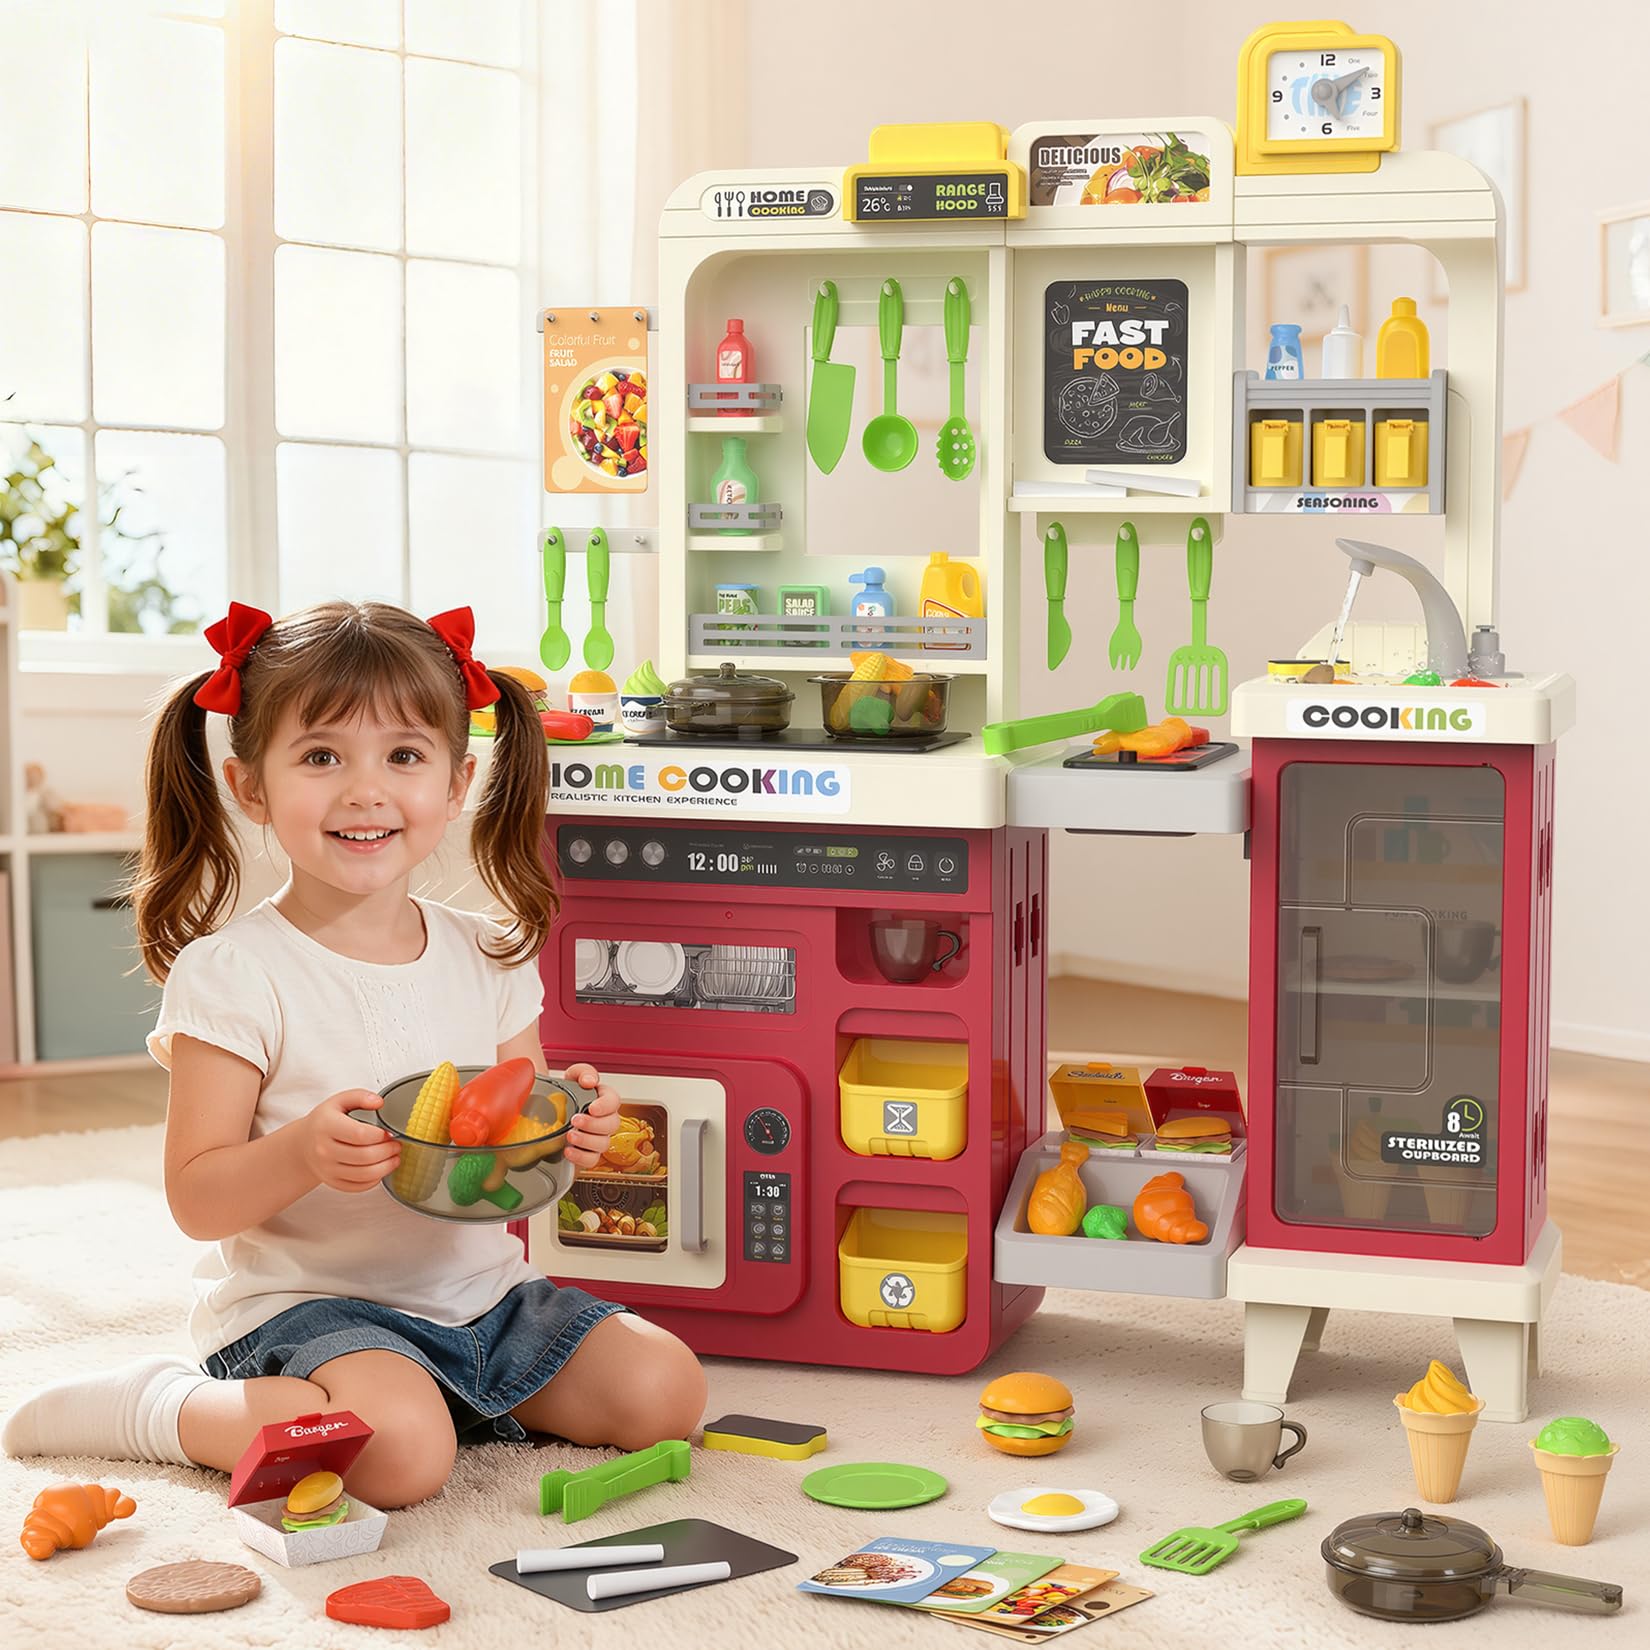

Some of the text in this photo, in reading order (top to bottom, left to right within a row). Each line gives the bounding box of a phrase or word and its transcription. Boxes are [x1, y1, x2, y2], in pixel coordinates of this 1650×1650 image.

[1320, 54, 1336, 66] 12
[1272, 90, 1283, 102] 9
[1370, 87, 1381, 100] 3
[1321, 122, 1332, 134] 6
[1040, 147, 1121, 166] DELICIOUS
[750, 190, 804, 203] HOME
[936, 184, 986, 196] RANGE
[936, 200, 978, 211] HOOD
[1072, 320, 1170, 346] FAST
[592, 334, 616, 346] Fruit
[550, 349, 574, 358] FRUIT
[1073, 346, 1167, 370] FOOD
[549, 358, 578, 367] SALAD
[1296, 496, 1379, 508] SEASONING
[786, 598, 814, 608] SALAD
[1302, 704, 1472, 732] COOKING
[658, 764, 840, 796] COOKING
[551, 792, 737, 806] REALISTIC KITCHEN EXPERIENCE
[688, 852, 739, 872] 12:00
[1447, 1112, 1460, 1133] 8
[1388, 1136, 1480, 1153] STERILIZED
[755, 1185, 780, 1198] 1:30
